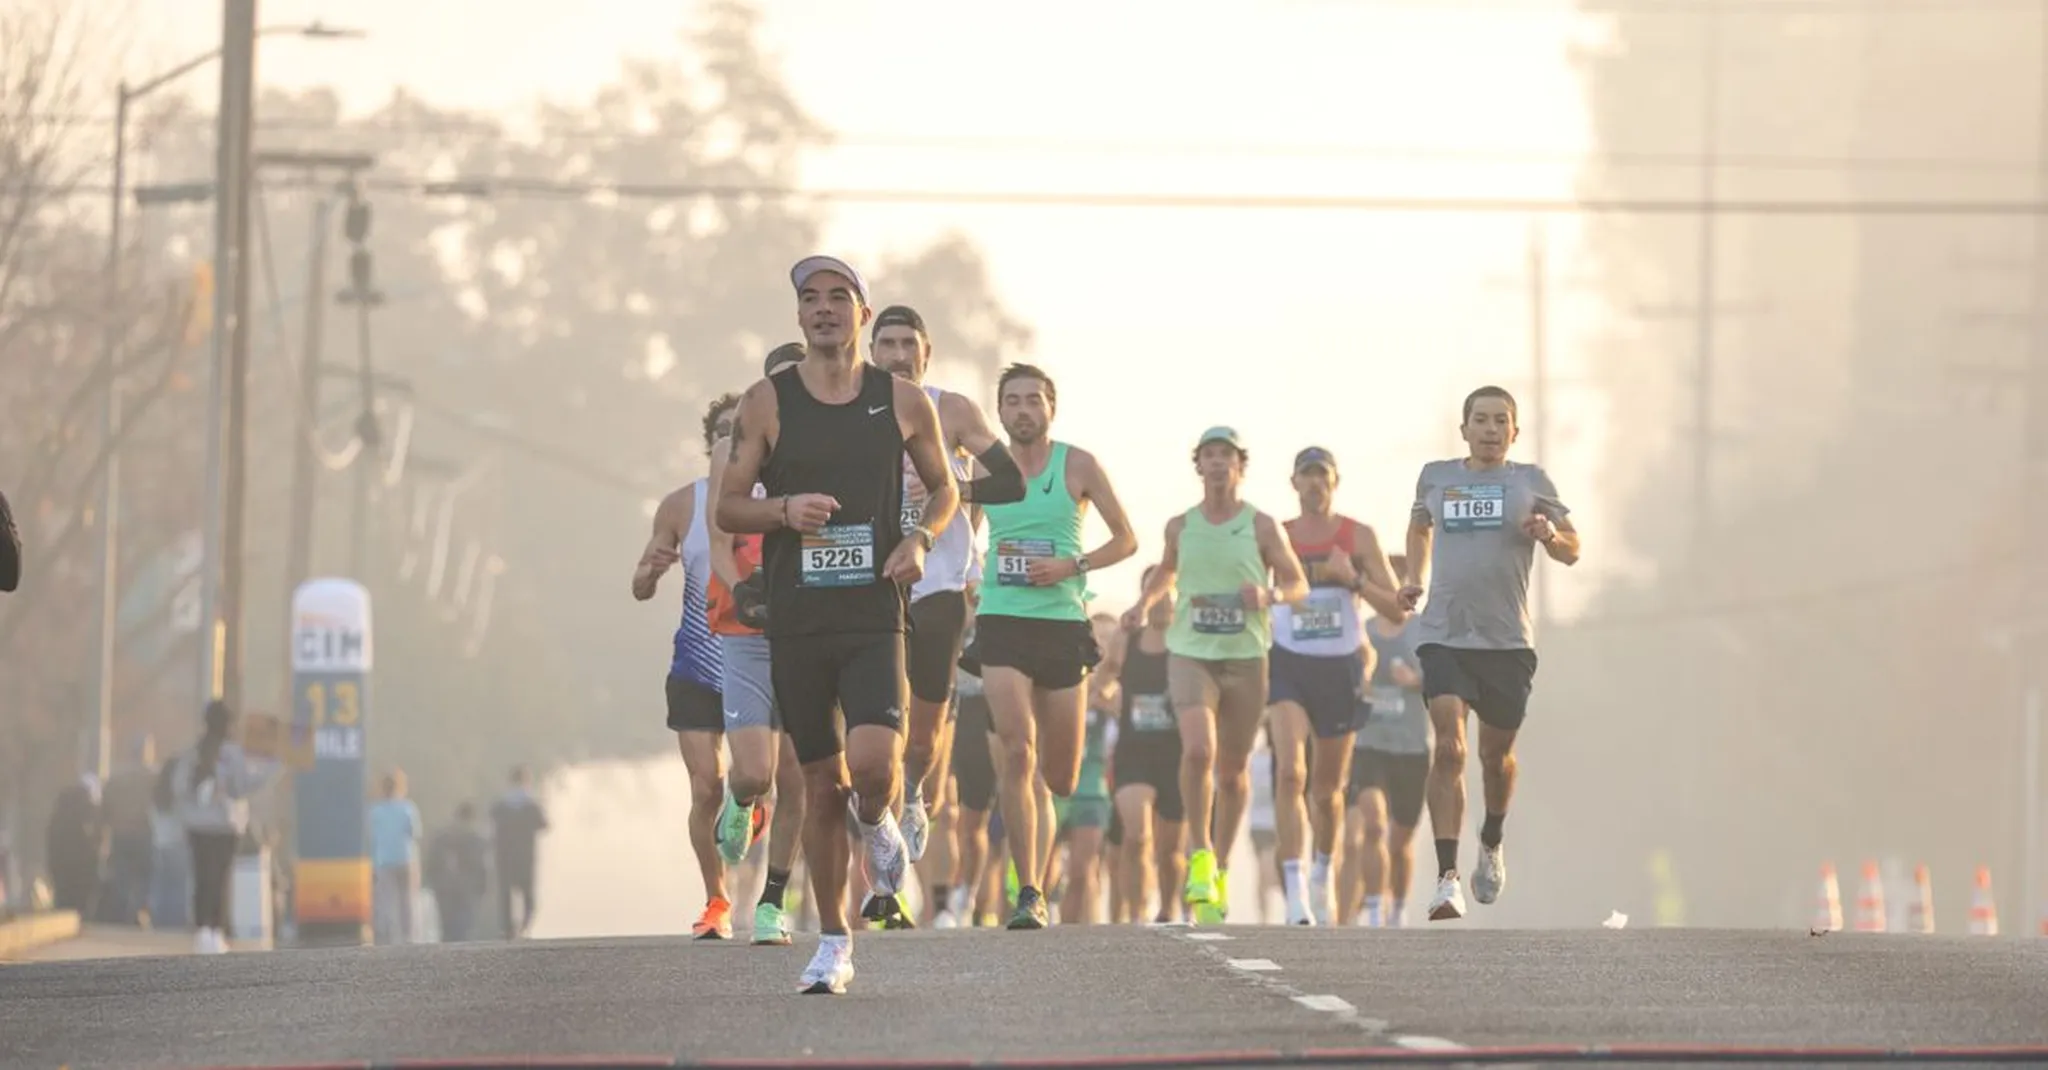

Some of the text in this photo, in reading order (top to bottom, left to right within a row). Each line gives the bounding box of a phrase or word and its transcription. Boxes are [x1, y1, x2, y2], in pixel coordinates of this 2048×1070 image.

[1452, 500, 1494, 517] 1169
[811, 548, 863, 569] 5226
[296, 629, 362, 662] CIM
[306, 680, 359, 727] 13
